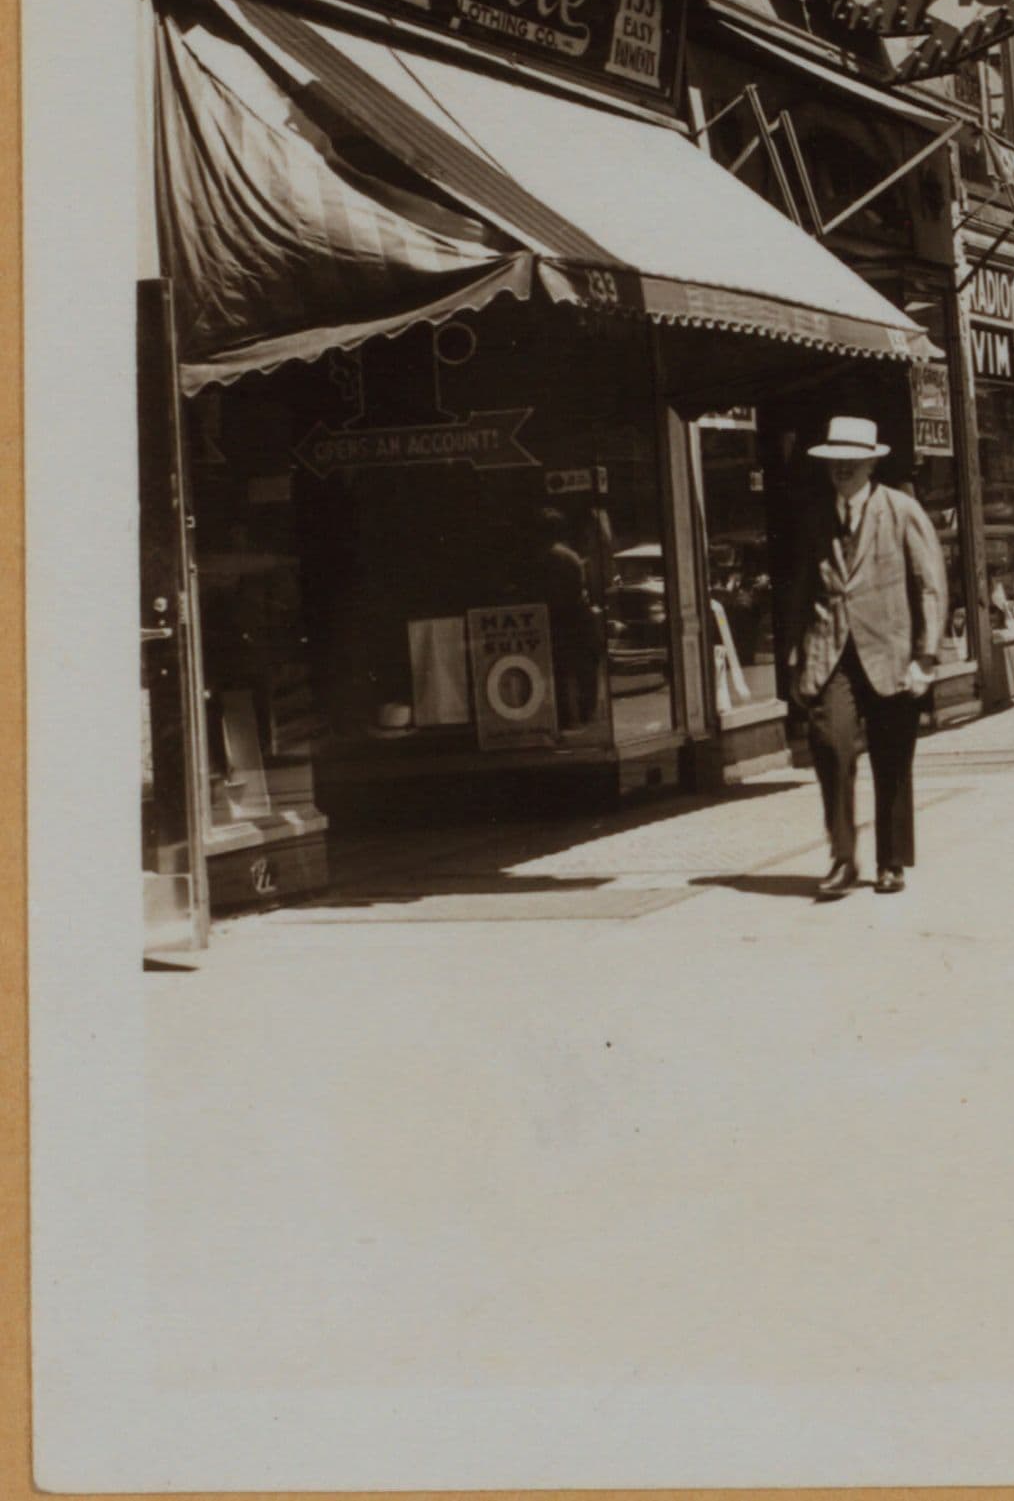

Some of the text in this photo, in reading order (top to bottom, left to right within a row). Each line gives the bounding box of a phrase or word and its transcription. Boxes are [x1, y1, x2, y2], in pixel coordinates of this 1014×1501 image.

[464, 1, 527, 37] OTHING
[622, 15, 655, 45] EASY
[971, 329, 1011, 377] VIM
[375, 434, 401, 457] AN
